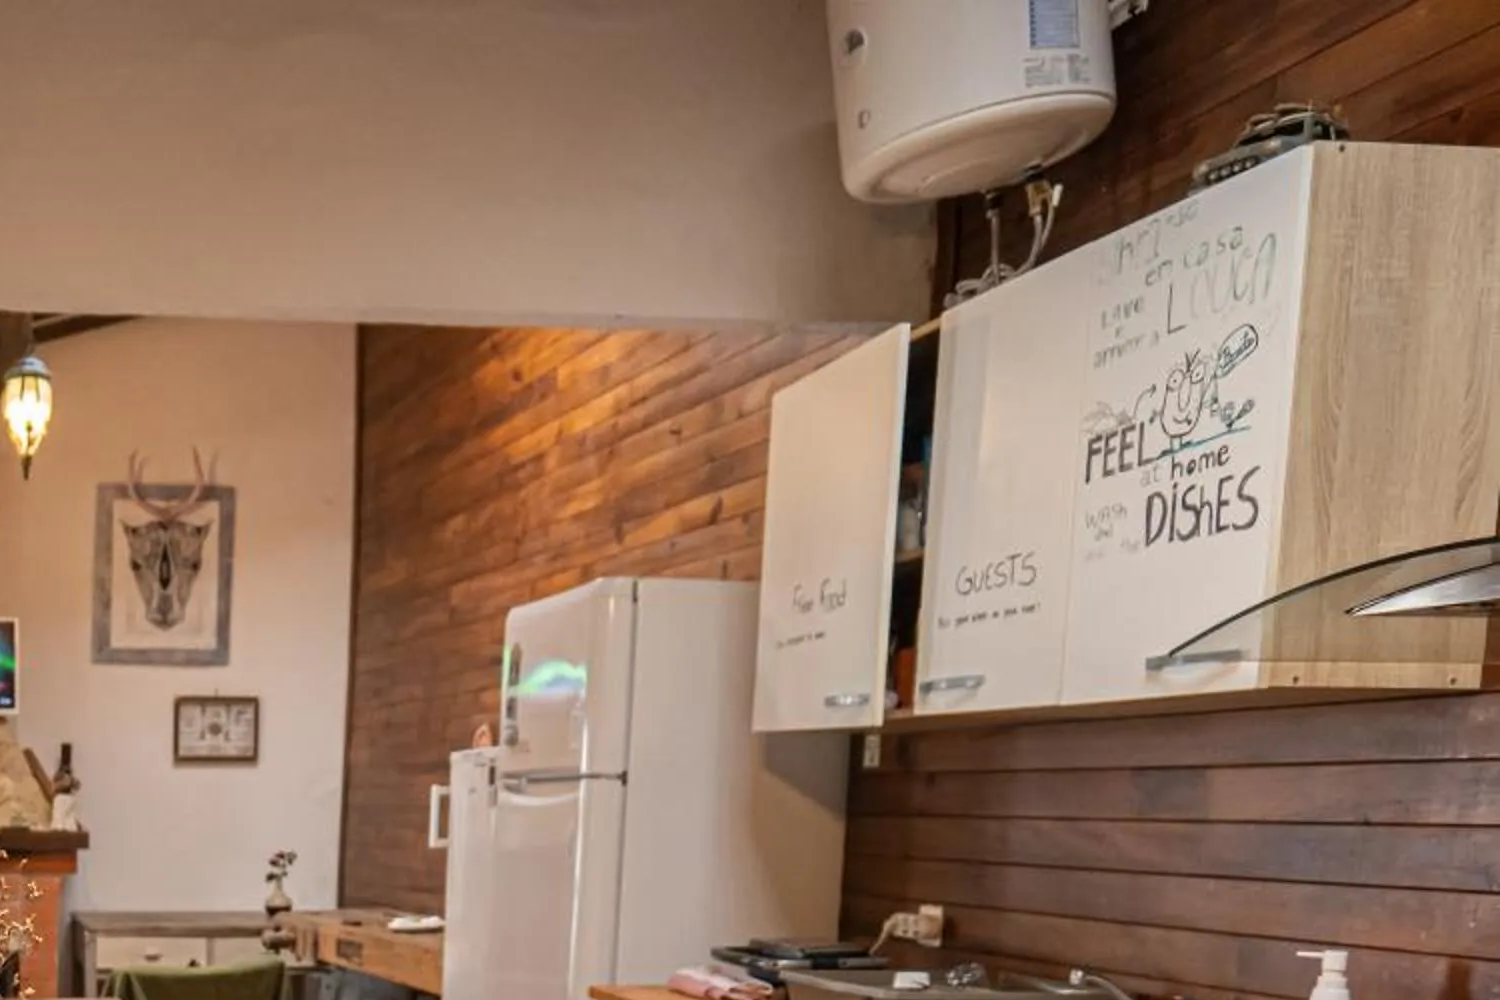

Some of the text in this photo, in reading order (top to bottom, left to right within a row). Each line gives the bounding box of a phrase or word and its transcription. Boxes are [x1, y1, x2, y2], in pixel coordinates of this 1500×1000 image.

[1084, 421, 1157, 485] FEEL
[1170, 444, 1231, 481] home
[955, 551, 1037, 597] GUESTS
